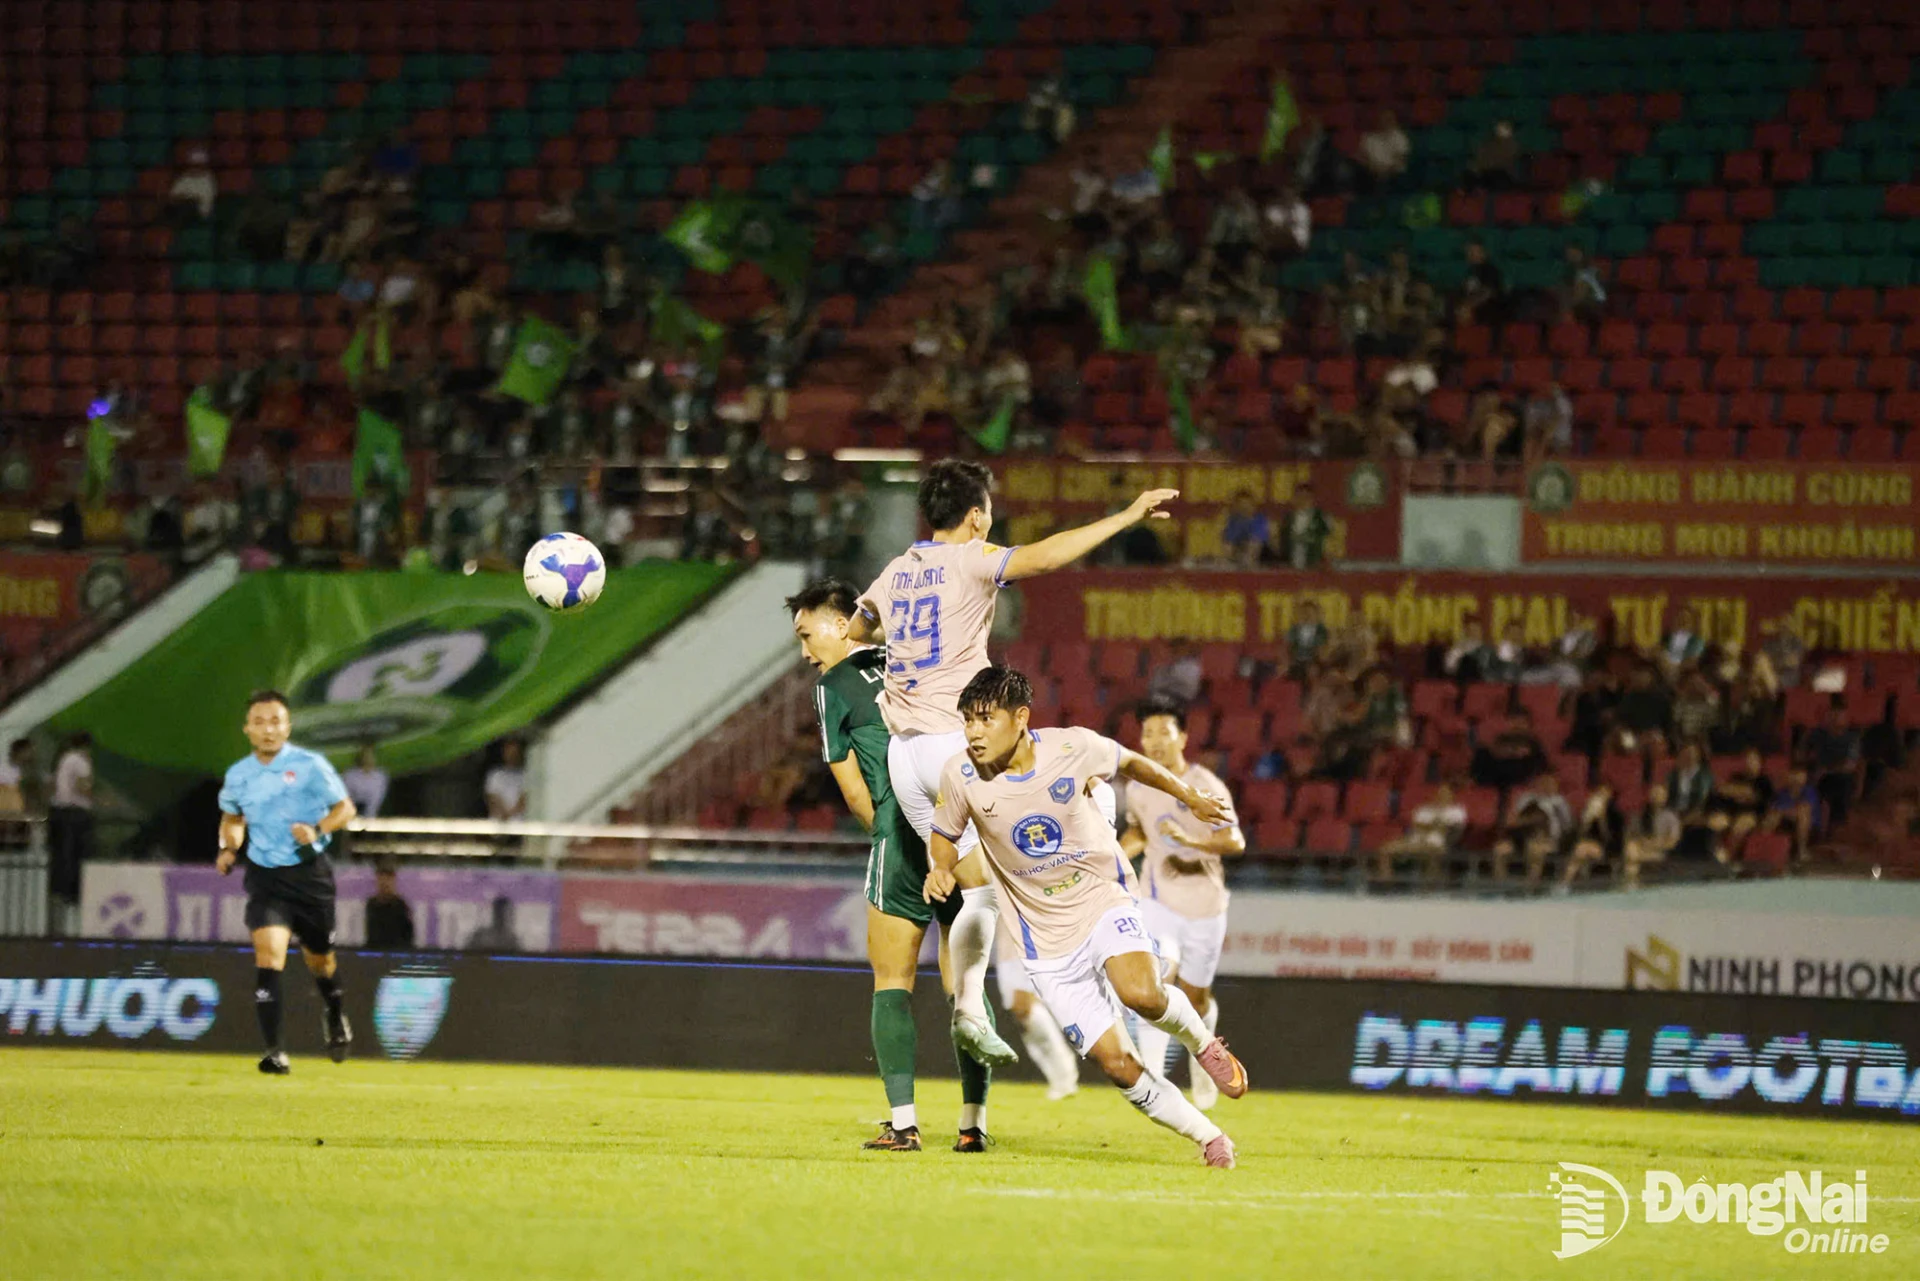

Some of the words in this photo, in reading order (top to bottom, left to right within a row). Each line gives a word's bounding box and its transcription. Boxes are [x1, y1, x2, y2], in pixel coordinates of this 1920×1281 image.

[1545, 522, 1664, 556] TRONG
[0, 960, 219, 1040] HƯỚC
[1687, 954, 1781, 994] NINH
[1350, 1010, 1629, 1096] DREAM
